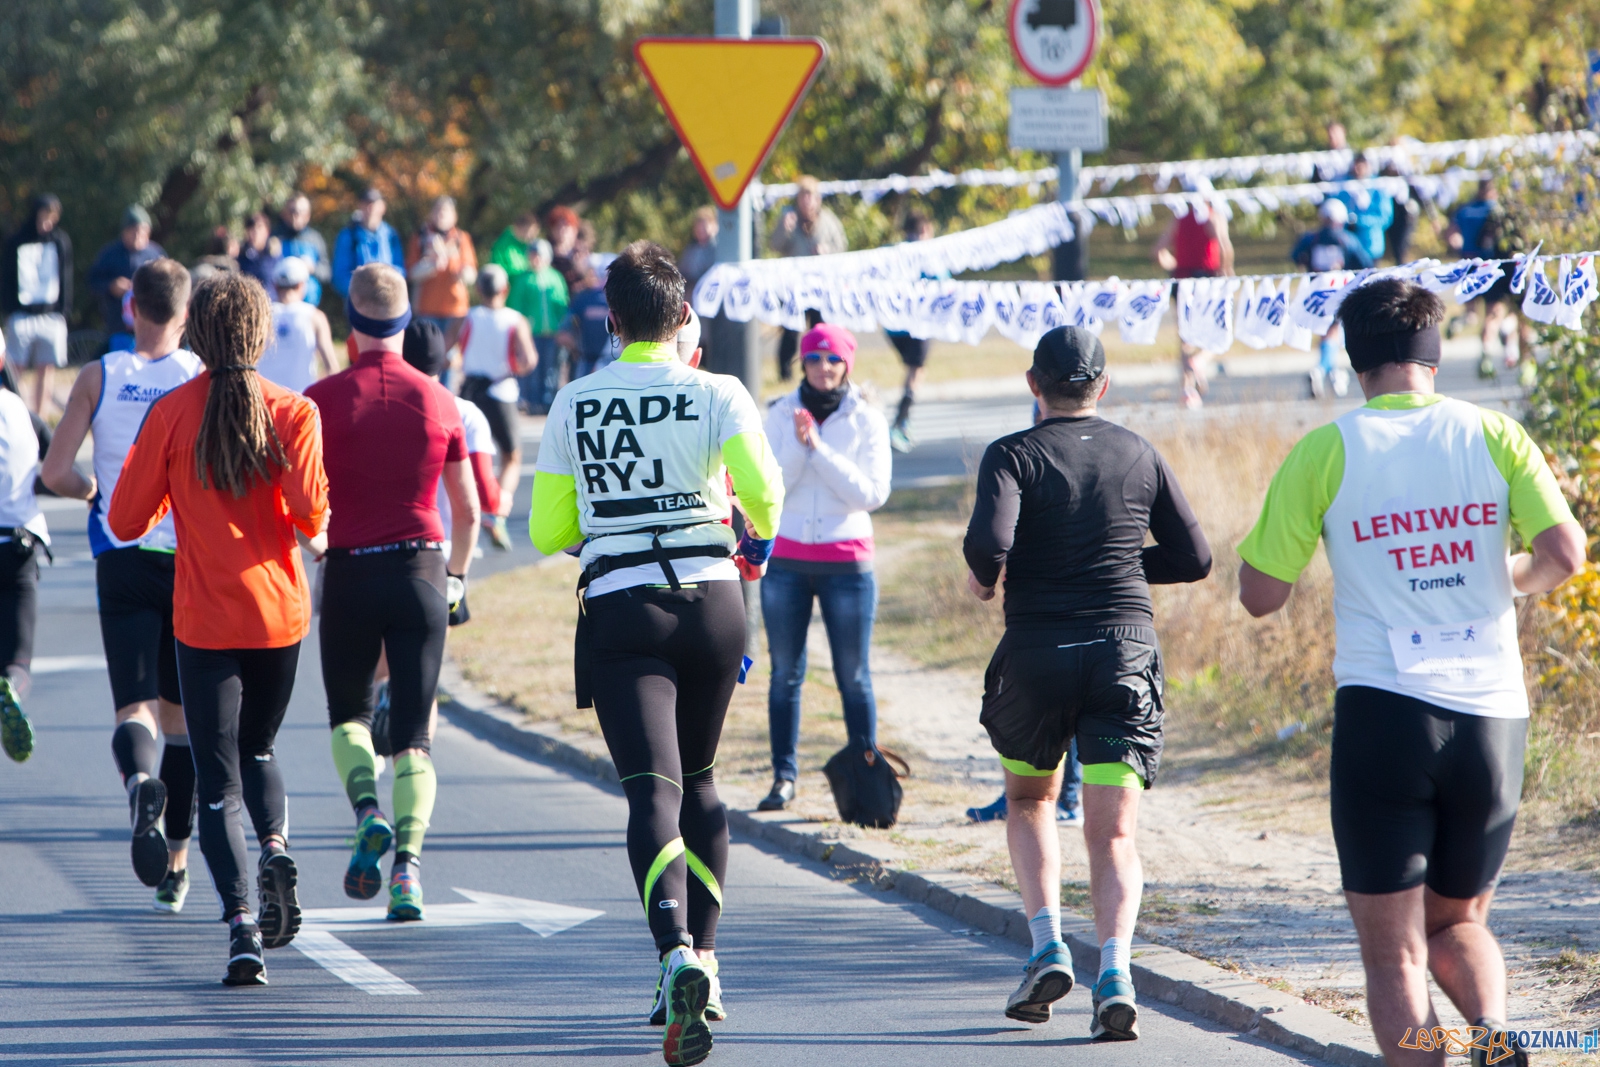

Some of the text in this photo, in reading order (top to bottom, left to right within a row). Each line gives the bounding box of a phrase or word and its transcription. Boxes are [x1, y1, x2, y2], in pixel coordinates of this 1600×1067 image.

[576, 393, 699, 429] PADŁ
[576, 428, 645, 461] NA
[582, 458, 664, 494] RYJ
[654, 494, 704, 511] TEAM
[1352, 503, 1498, 543] LENIWCE
[1388, 540, 1475, 571] TEAM
[1408, 573, 1466, 592] Tomek
